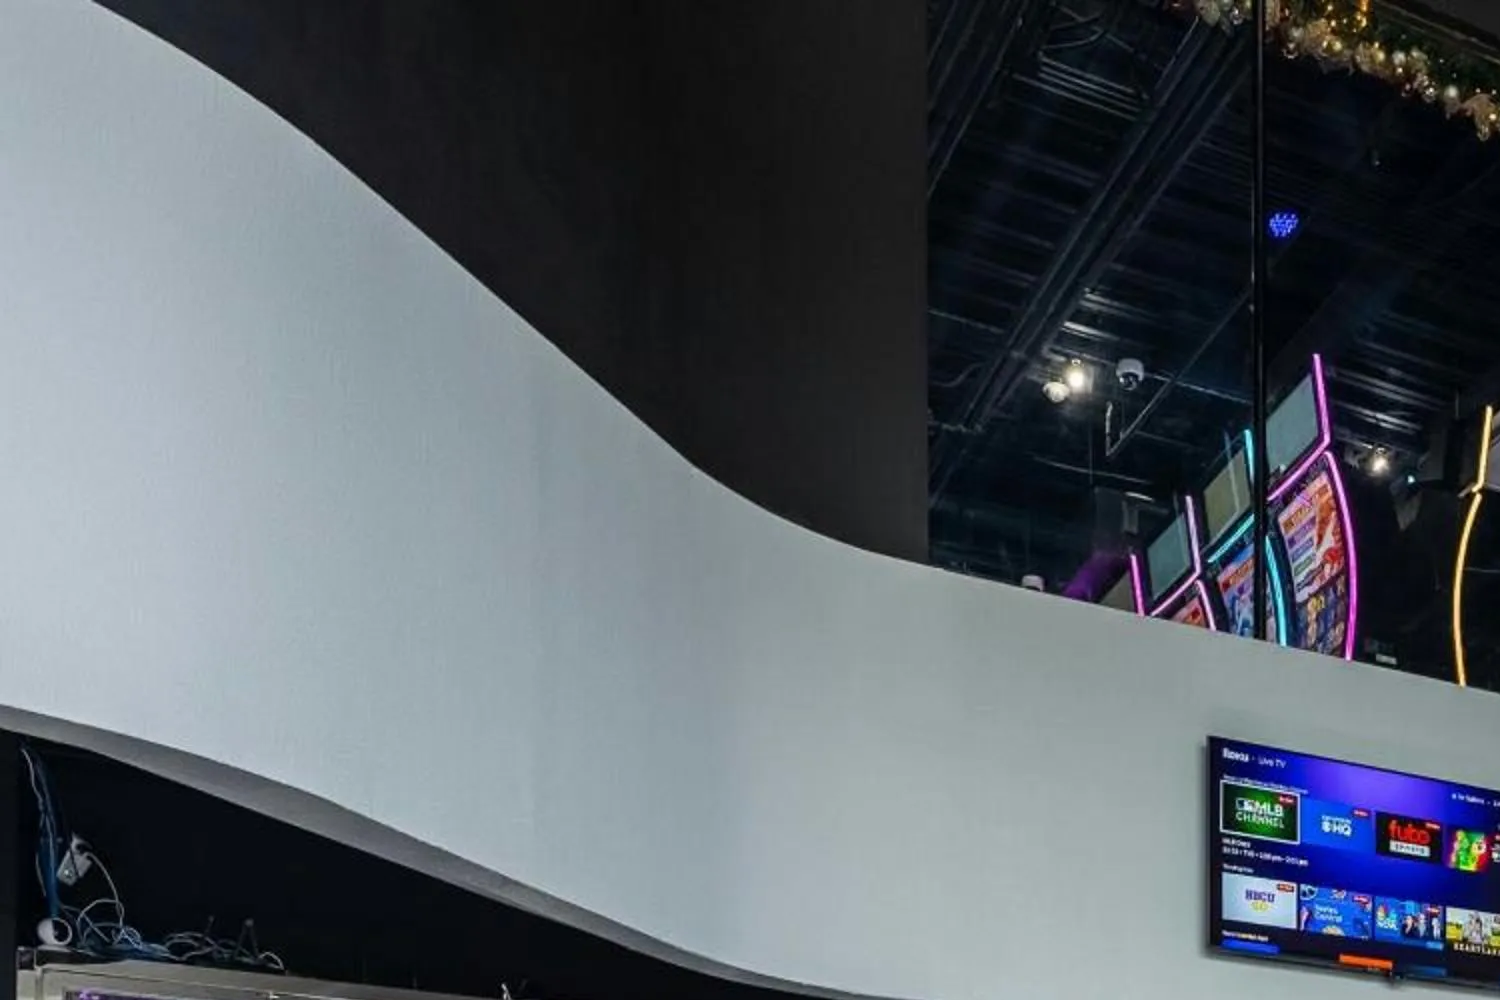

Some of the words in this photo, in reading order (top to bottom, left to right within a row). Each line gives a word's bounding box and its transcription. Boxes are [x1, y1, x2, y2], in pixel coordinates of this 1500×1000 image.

[1276, 759, 1287, 768] TV
[1256, 800, 1284, 817] MLB
[1236, 811, 1284, 829] CHANNEL
[1388, 820, 1431, 844] fubo
